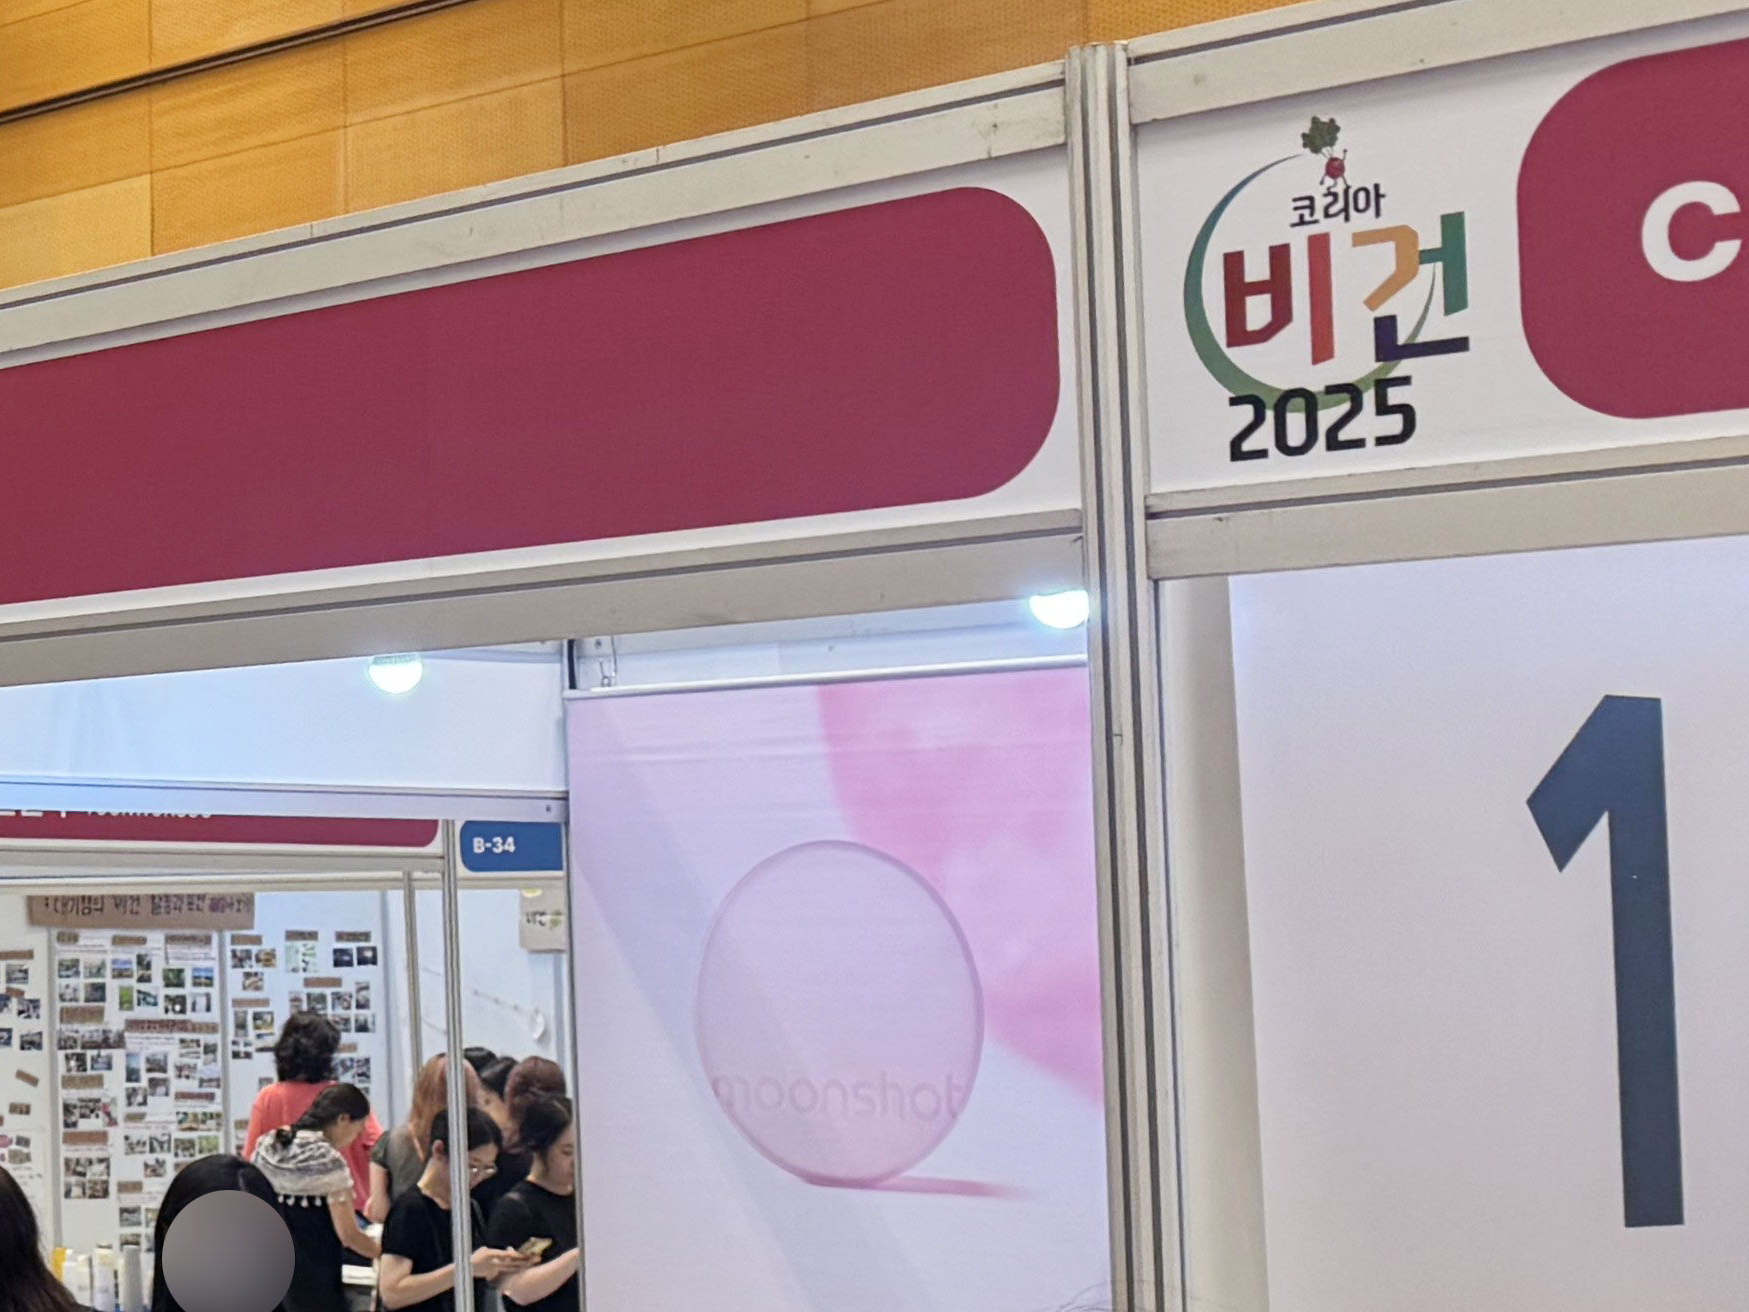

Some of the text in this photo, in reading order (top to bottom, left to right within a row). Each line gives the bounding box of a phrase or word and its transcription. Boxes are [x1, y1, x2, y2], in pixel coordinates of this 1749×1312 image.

[1289, 182, 1387, 230] 코리아
[1223, 211, 1470, 366] 비건
[1228, 375, 1417, 462] 2025
[472, 836, 516, 854] B-34
[710, 1072, 963, 1123] moonshot
